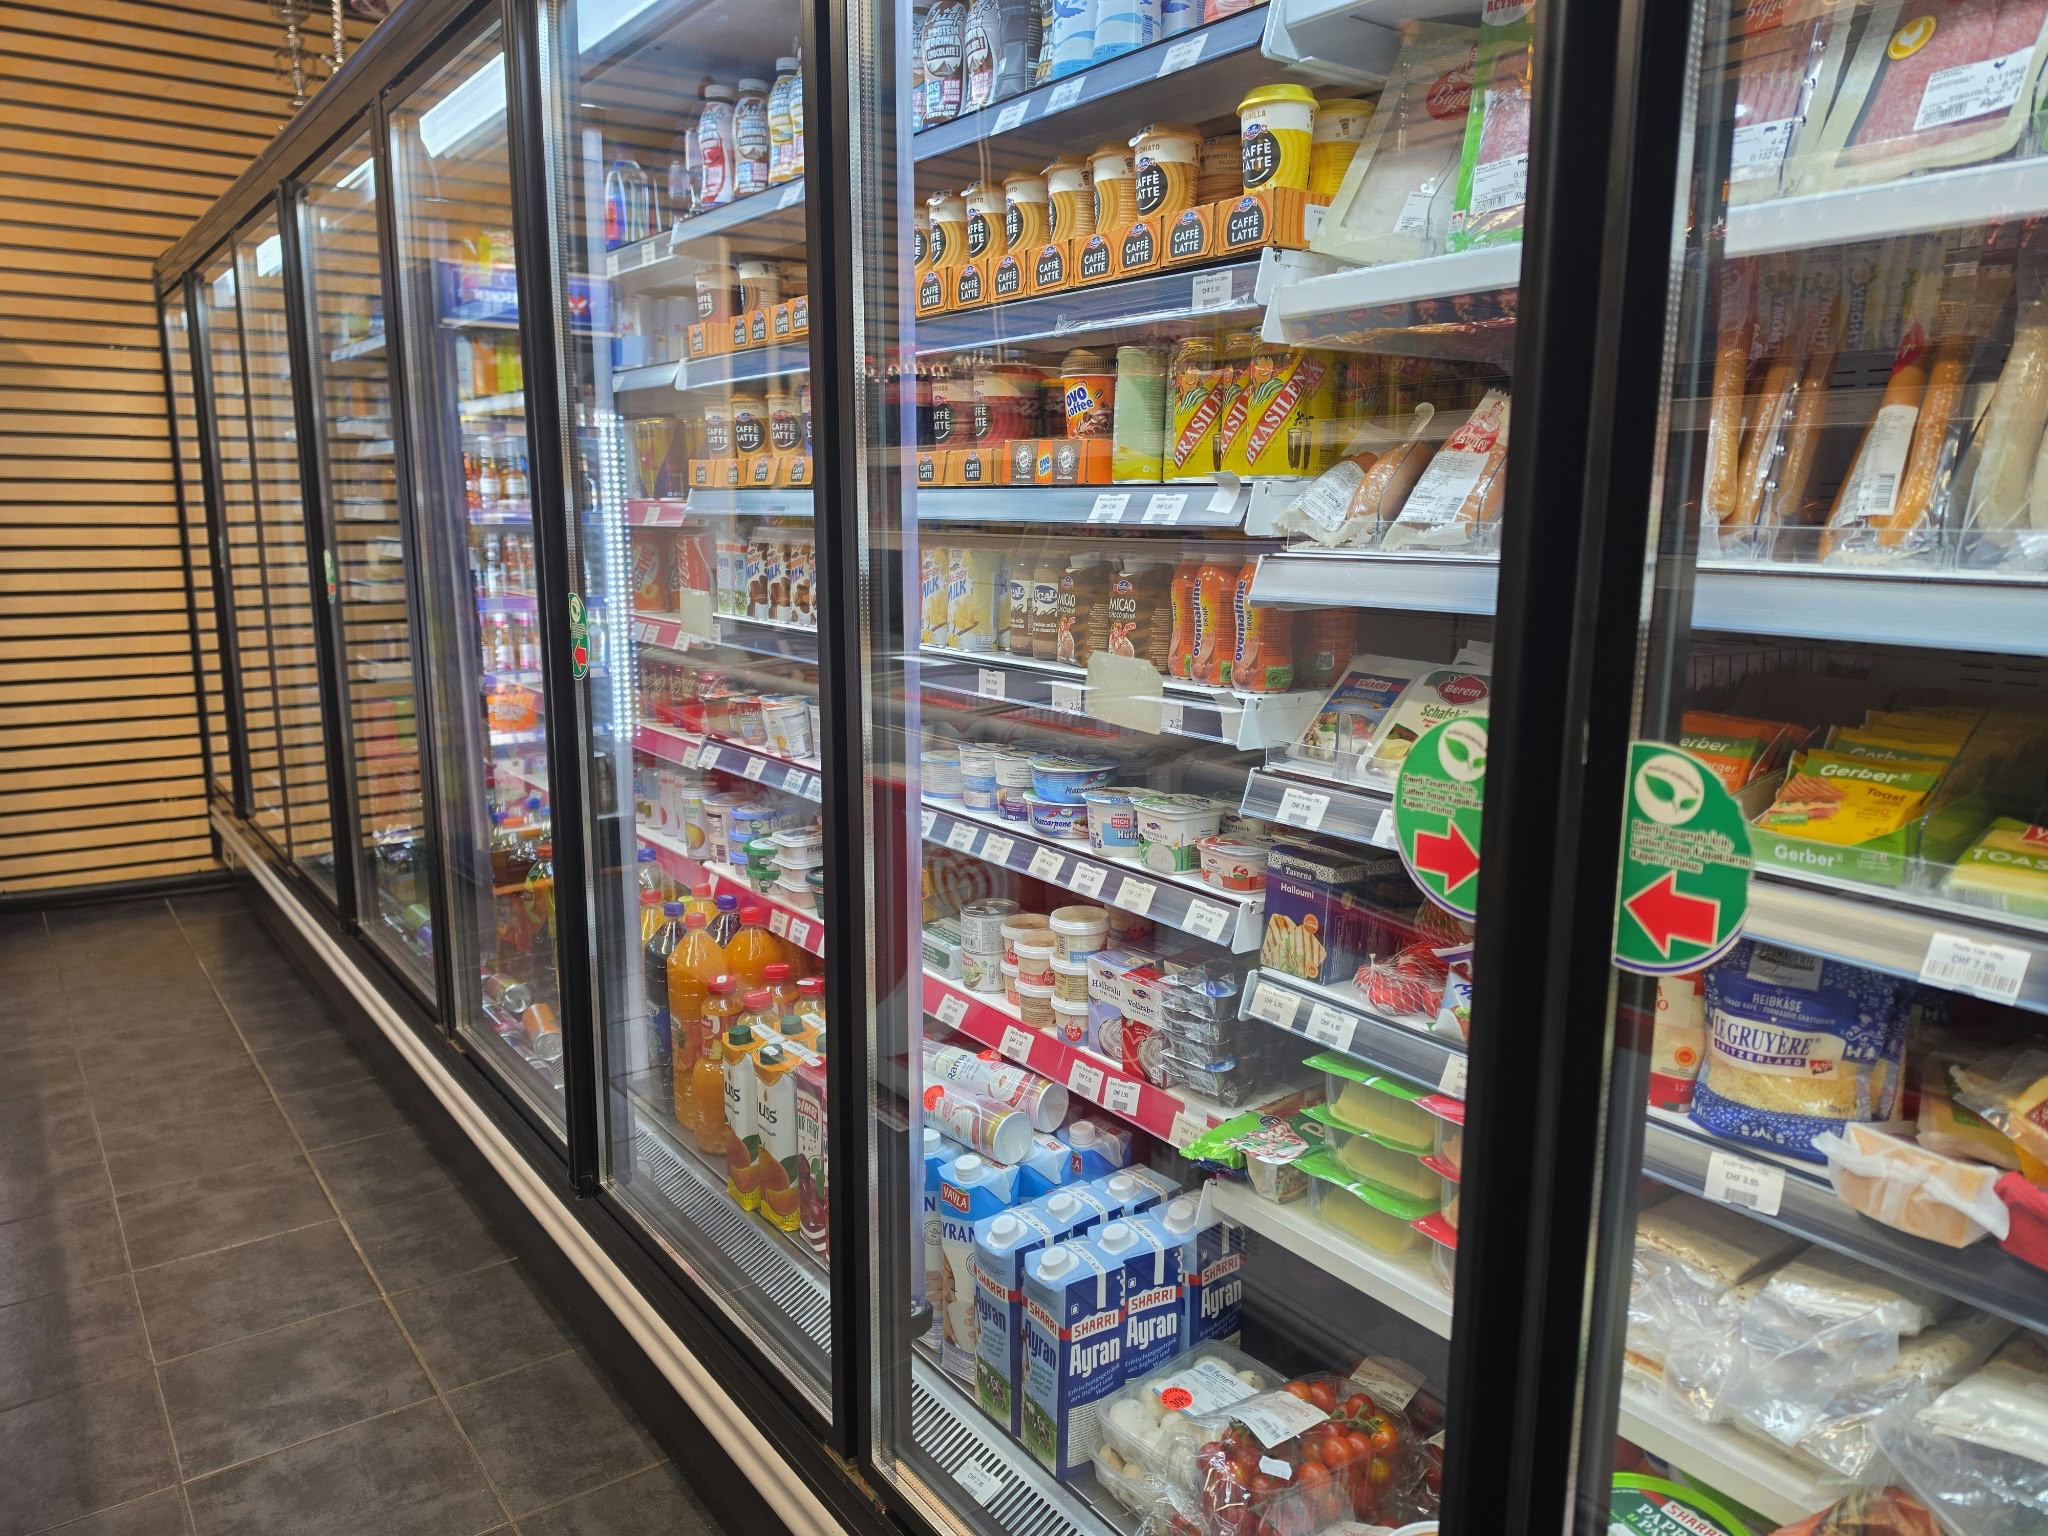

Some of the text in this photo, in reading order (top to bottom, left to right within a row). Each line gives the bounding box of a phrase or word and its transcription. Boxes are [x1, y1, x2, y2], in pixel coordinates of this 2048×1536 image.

[1231, 210, 1259, 231] CAFFÈ
[1174, 225, 1200, 243] CAFFÈ
[1231, 226, 1259, 244] LATTE
[1126, 237, 1149, 255] CAFFÈ
[1174, 240, 1199, 254] LATTE
[1039, 257, 1060, 273] CAFFÈ
[1084, 249, 1106, 265] CAFFÈ
[1126, 251, 1149, 265] LATTE
[997, 268, 1017, 283] CAFFÈ
[1039, 269, 1060, 284] LATTE
[1084, 262, 1106, 275] LATTE
[922, 283, 939, 297] CAFFÈ
[960, 276, 979, 291] CAFFÈ
[998, 280, 1017, 292] LATTE
[922, 295, 939, 305] LATTE
[960, 289, 979, 300] LATTE
[1066, 387, 1088, 406] OVO
[1066, 399, 1095, 419] coffee
[706, 427, 729, 436] CAFFÈ
[735, 423, 759, 434] CAFFÈ
[771, 420, 796, 431] CAFFÈ
[707, 434, 729, 444] LATTE
[736, 432, 760, 443] LATTE
[772, 430, 796, 440] LATTE
[919, 464, 933, 472] CAFFÈ
[966, 462, 980, 471] CAFFÈ
[966, 470, 980, 479] LATTE
[919, 471, 933, 479] LATTE
[1010, 585, 1025, 600] CAL
[1108, 598, 1136, 614] MICAO
[1192, 577, 1202, 658] ovomaltine
[1233, 580, 1247, 663] ovomaltine
[1356, 679, 1393, 692] SHARRI
[1444, 684, 1481, 698] Berem
[1679, 736, 1730, 753] erber
[1820, 763, 1898, 784] Gerber
[1866, 787, 1906, 802] Toast
[1033, 815, 1073, 830] Mascarpone
[1774, 844, 1835, 867] Gerber
[1285, 865, 1313, 881] Taverna
[1280, 881, 1315, 900] Halloumi
[1952, 954, 1971, 967] CHF
[1752, 992, 1803, 1012] REIBKÄSE
[1714, 1015, 1814, 1057] LE GRUYÈRE
[1714, 1039, 1803, 1067] SWITZERLAND
[1726, 1170, 1760, 1188] CHF 3.95
[1204, 1259, 1238, 1283] SHARRI
[976, 1267, 1007, 1300] SHARRI
[1131, 1288, 1173, 1311] SHARRI
[1200, 1279, 1242, 1320] Ayran
[1028, 1301, 1058, 1335] SHARRI
[1074, 1311, 1117, 1338] SHARRI
[1126, 1311, 1177, 1350] Ayran
[1025, 1318, 1057, 1371] Ayran
[1124, 1336, 1177, 1369] Erfrischungsgetränk
[1068, 1337, 1120, 1379] Ayran
[1127, 1348, 1170, 1373] aus Joghurt und
[1067, 1363, 1121, 1398] Erfrischungsgetränk
[1212, 1369, 1238, 1388] funghi
[1081, 1381, 1103, 1400] Joghurt
[1101, 1374, 1114, 1387] und
